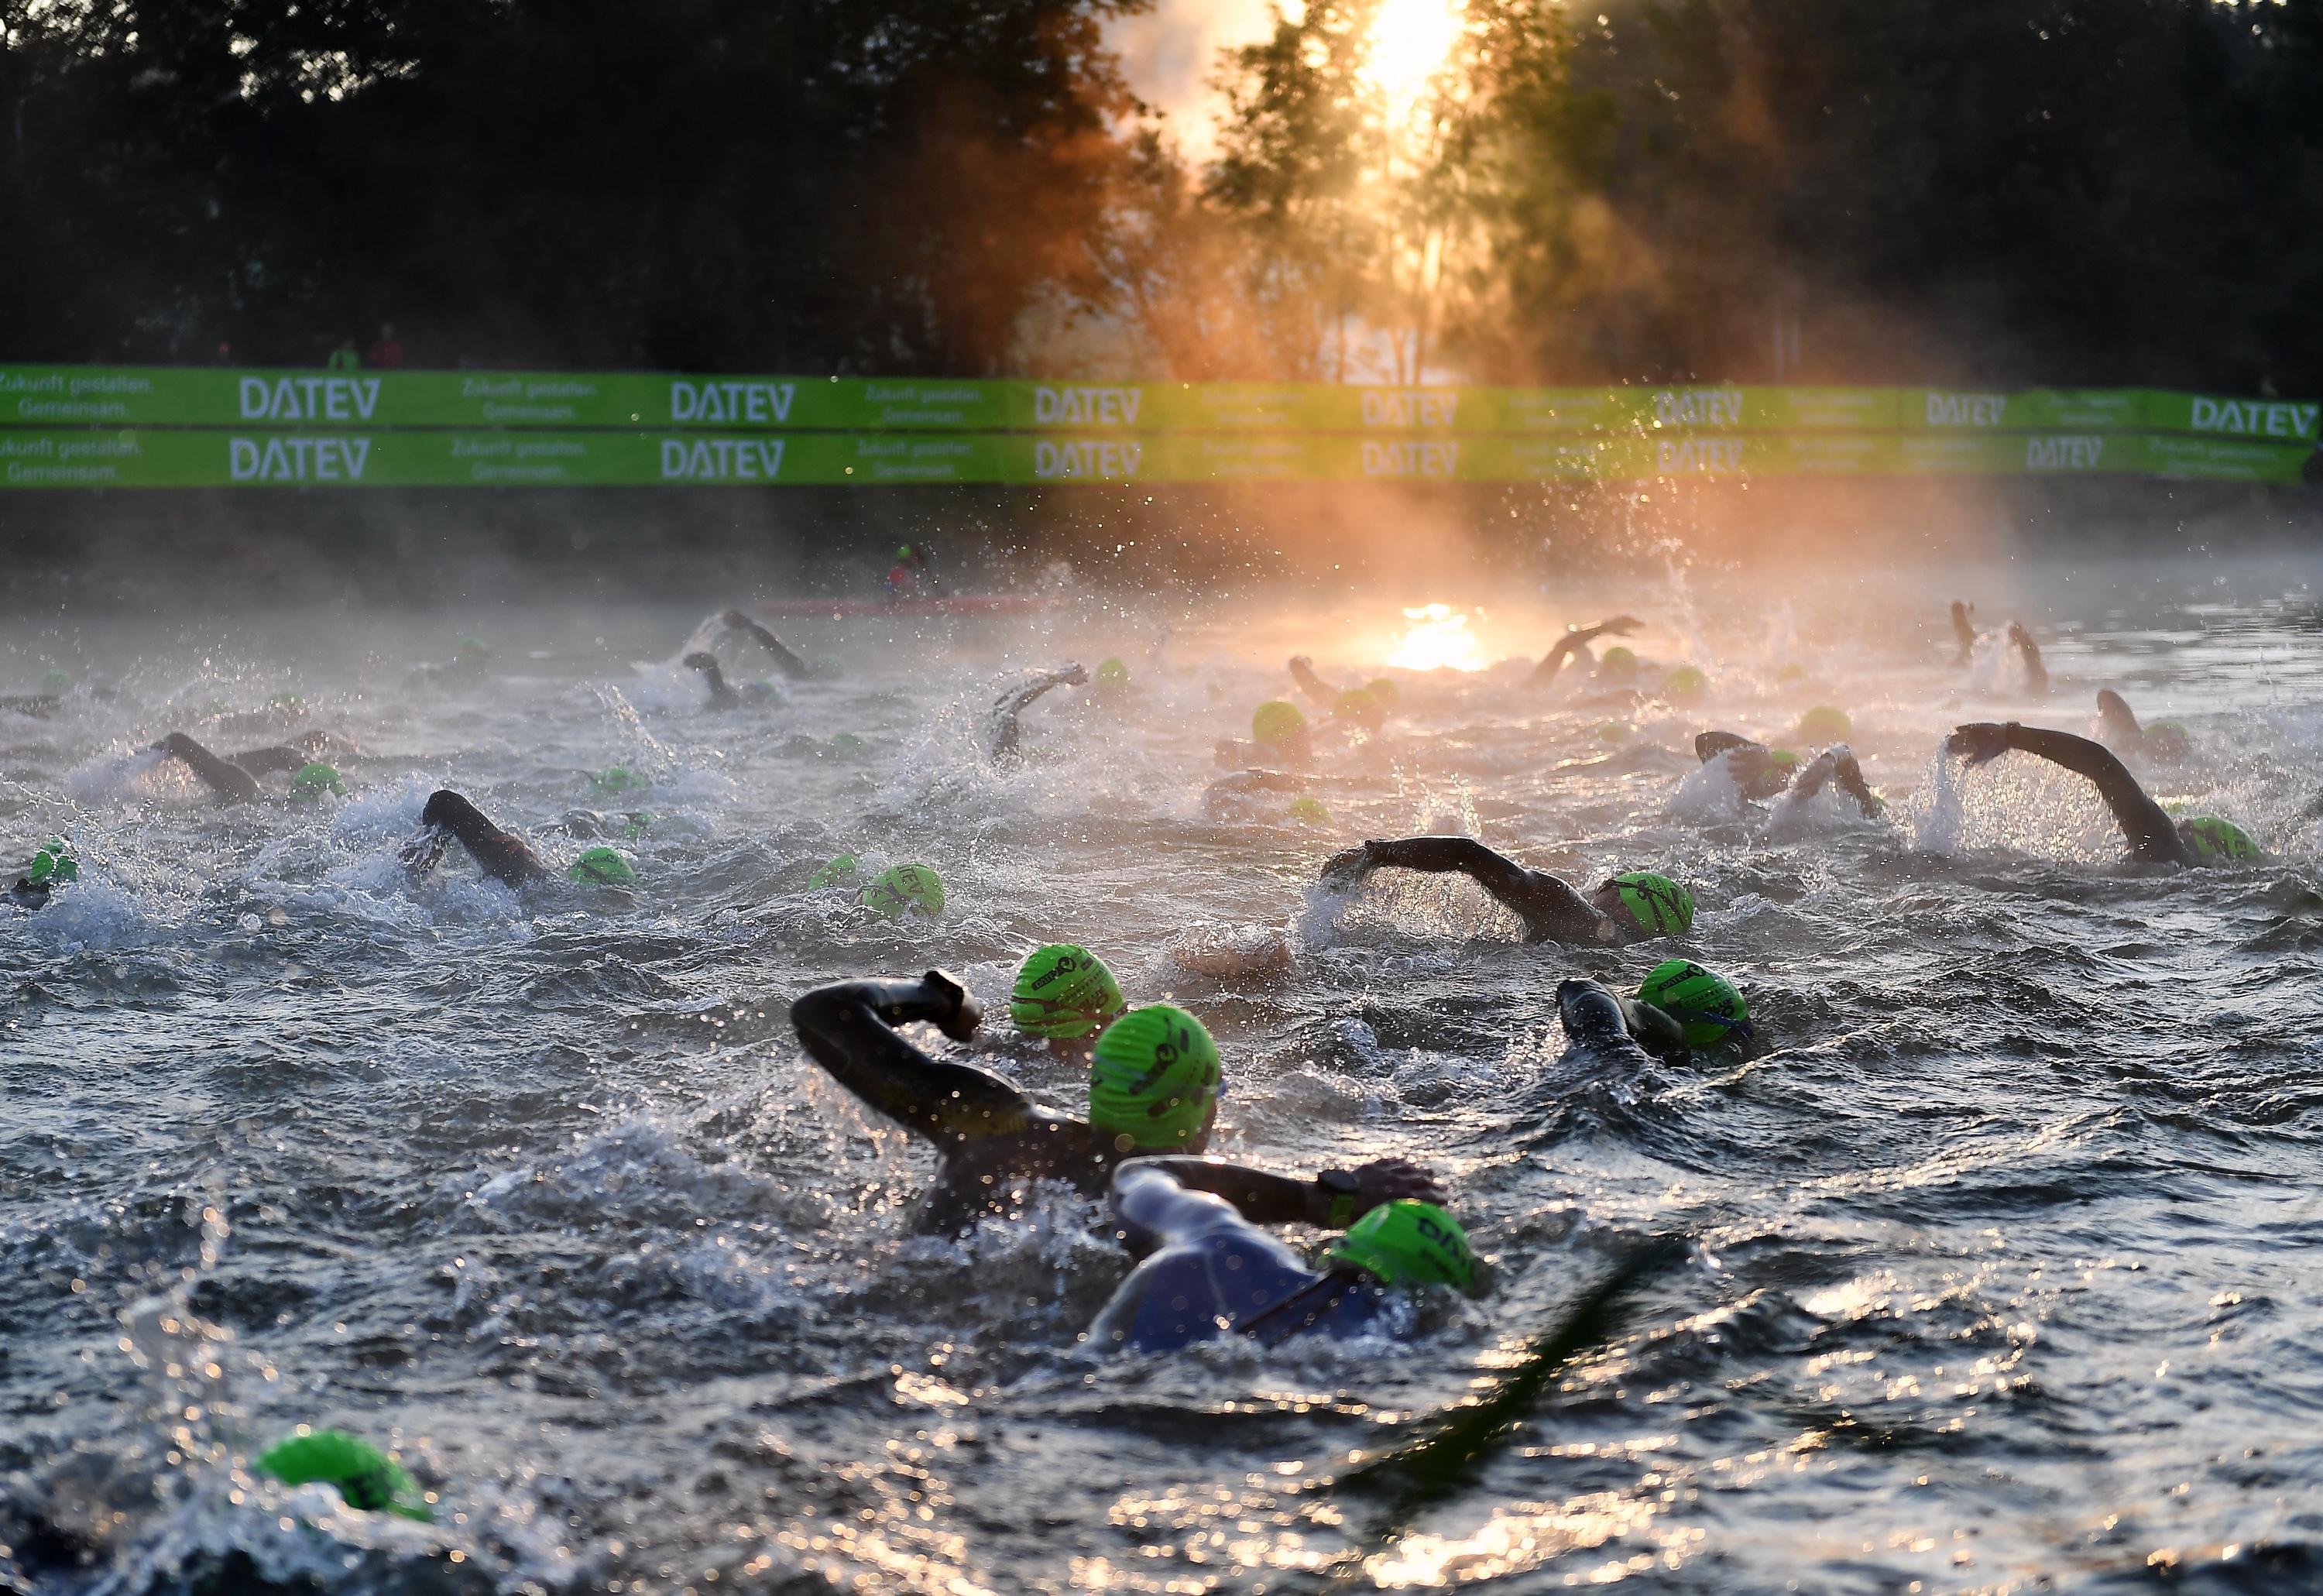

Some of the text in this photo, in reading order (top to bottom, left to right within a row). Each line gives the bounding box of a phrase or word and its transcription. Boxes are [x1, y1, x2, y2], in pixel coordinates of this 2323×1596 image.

[238, 376, 382, 420] DATEV
[671, 381, 796, 423] DATEV
[1034, 386, 1141, 425] DATEV
[1360, 391, 1459, 427] DATEV
[1656, 391, 1743, 425] DATEV
[1926, 392, 2006, 427] DATEV
[2190, 396, 2318, 438] DATEV
[229, 437, 371, 481] DATEV
[661, 438, 786, 479] DATEV
[1035, 441, 1142, 478] DATEV
[1360, 441, 1460, 476] DATEV
[1656, 439, 1744, 473] DATEV
[2026, 436, 2103, 470] DATEV
[1661, 970, 1689, 990] DATEV
